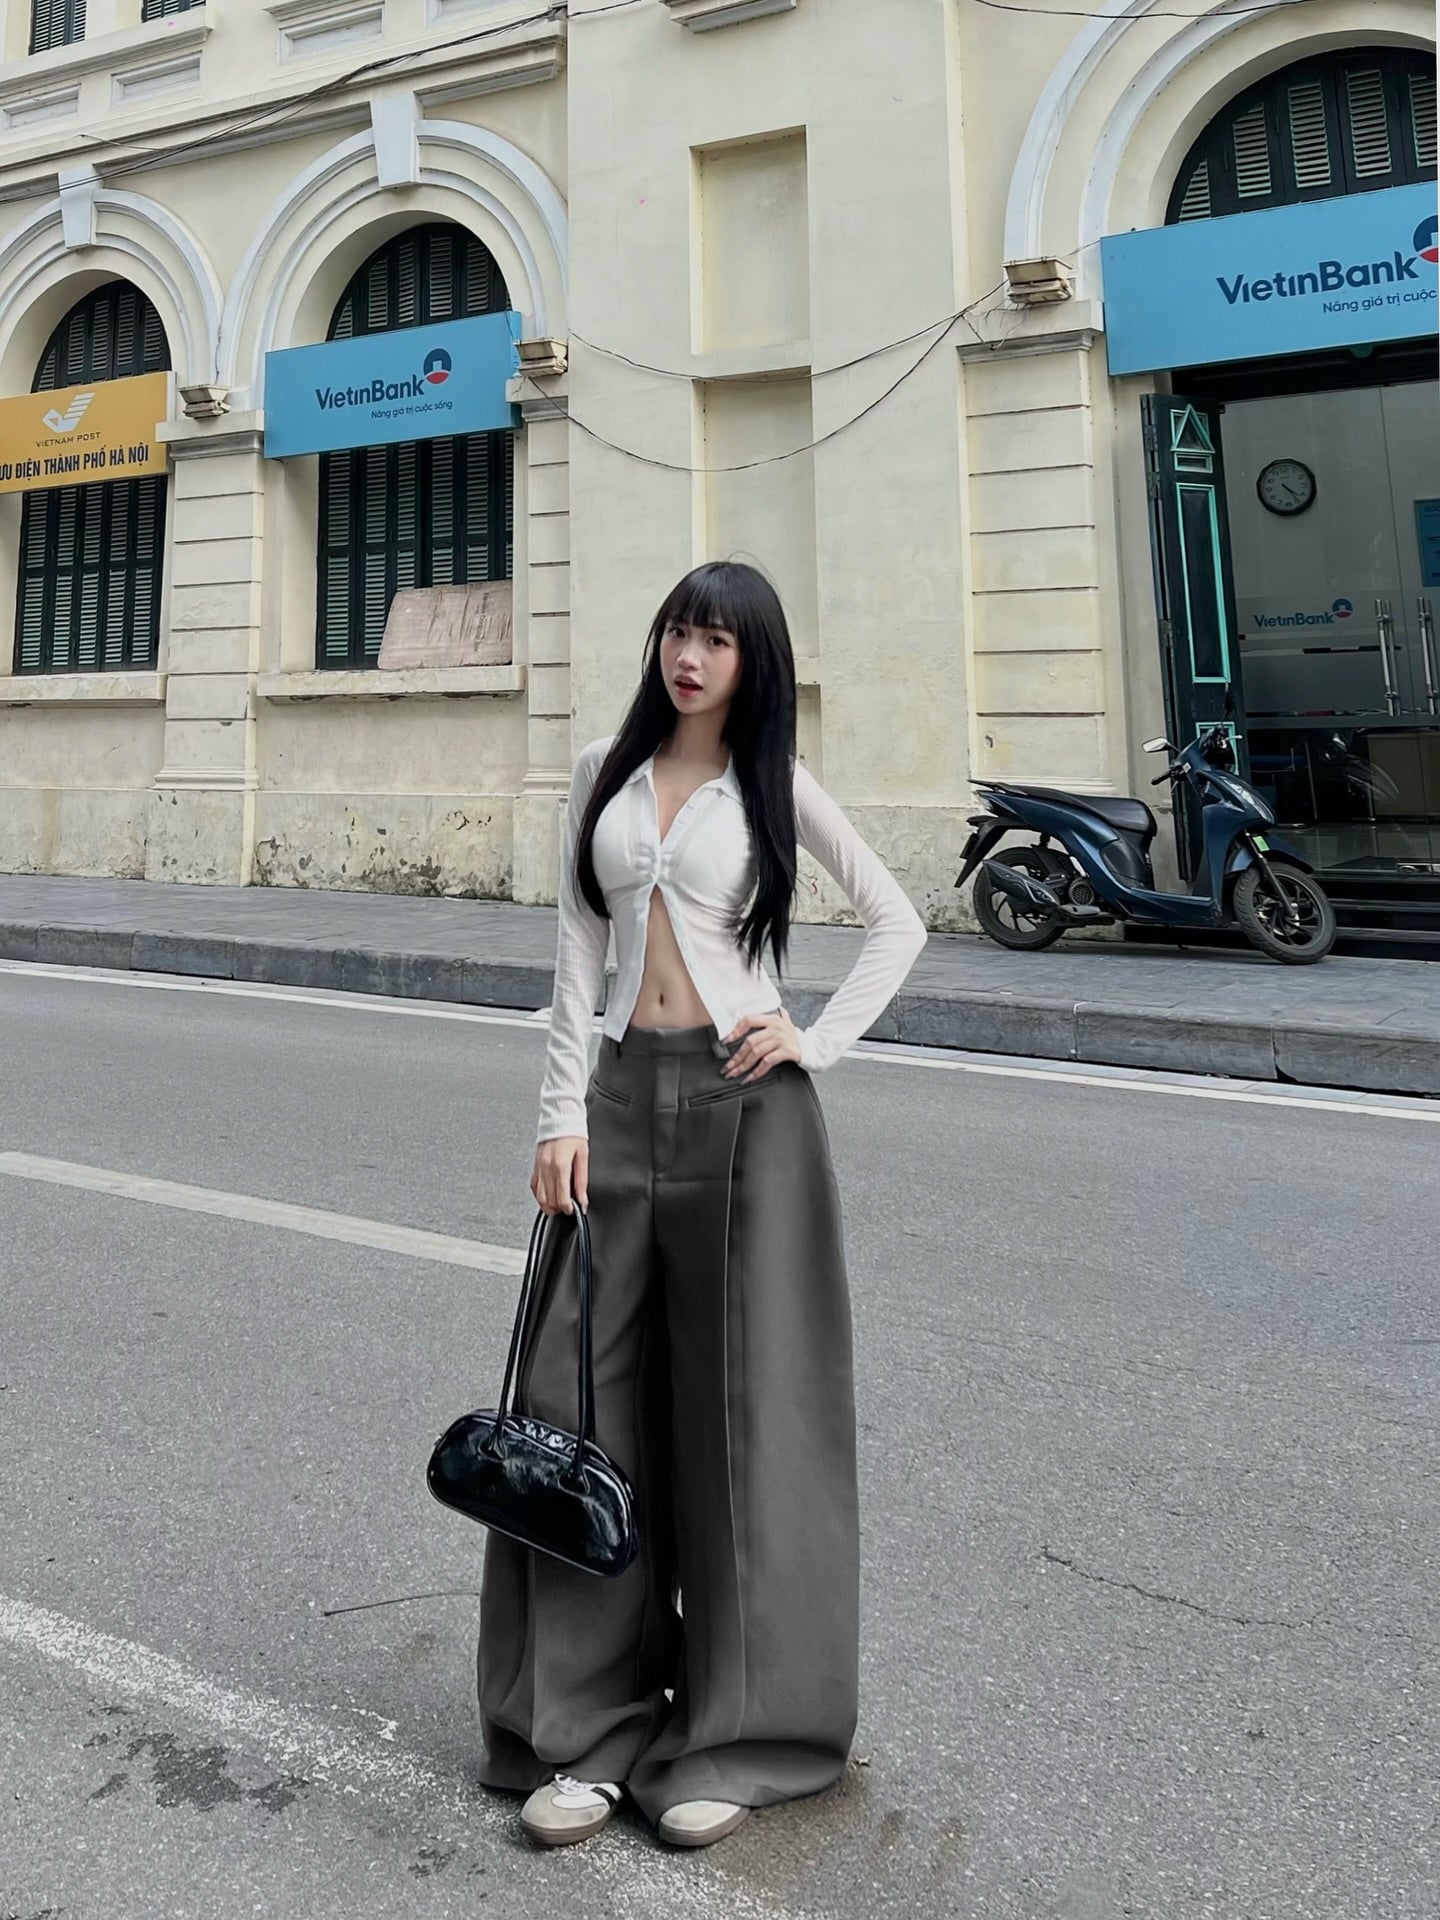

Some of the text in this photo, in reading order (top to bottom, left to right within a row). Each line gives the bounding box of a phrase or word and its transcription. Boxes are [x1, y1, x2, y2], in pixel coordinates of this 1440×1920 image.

[1216, 251, 1420, 305] VietinBank
[1323, 288, 1437, 313] Nâng giá trị cuộc
[315, 374, 425, 410] VietinBank
[415, 403, 433, 412] cuộc
[434, 400, 453, 411] sống
[36, 431, 101, 447] VIETNAM POST
[44, 453, 80, 474] THÀNH
[83, 444, 106, 470] PHỐ
[109, 445, 125, 466] HÀ
[128, 442, 149, 466] NỘI
[1253, 611, 1335, 628] VietinBank
